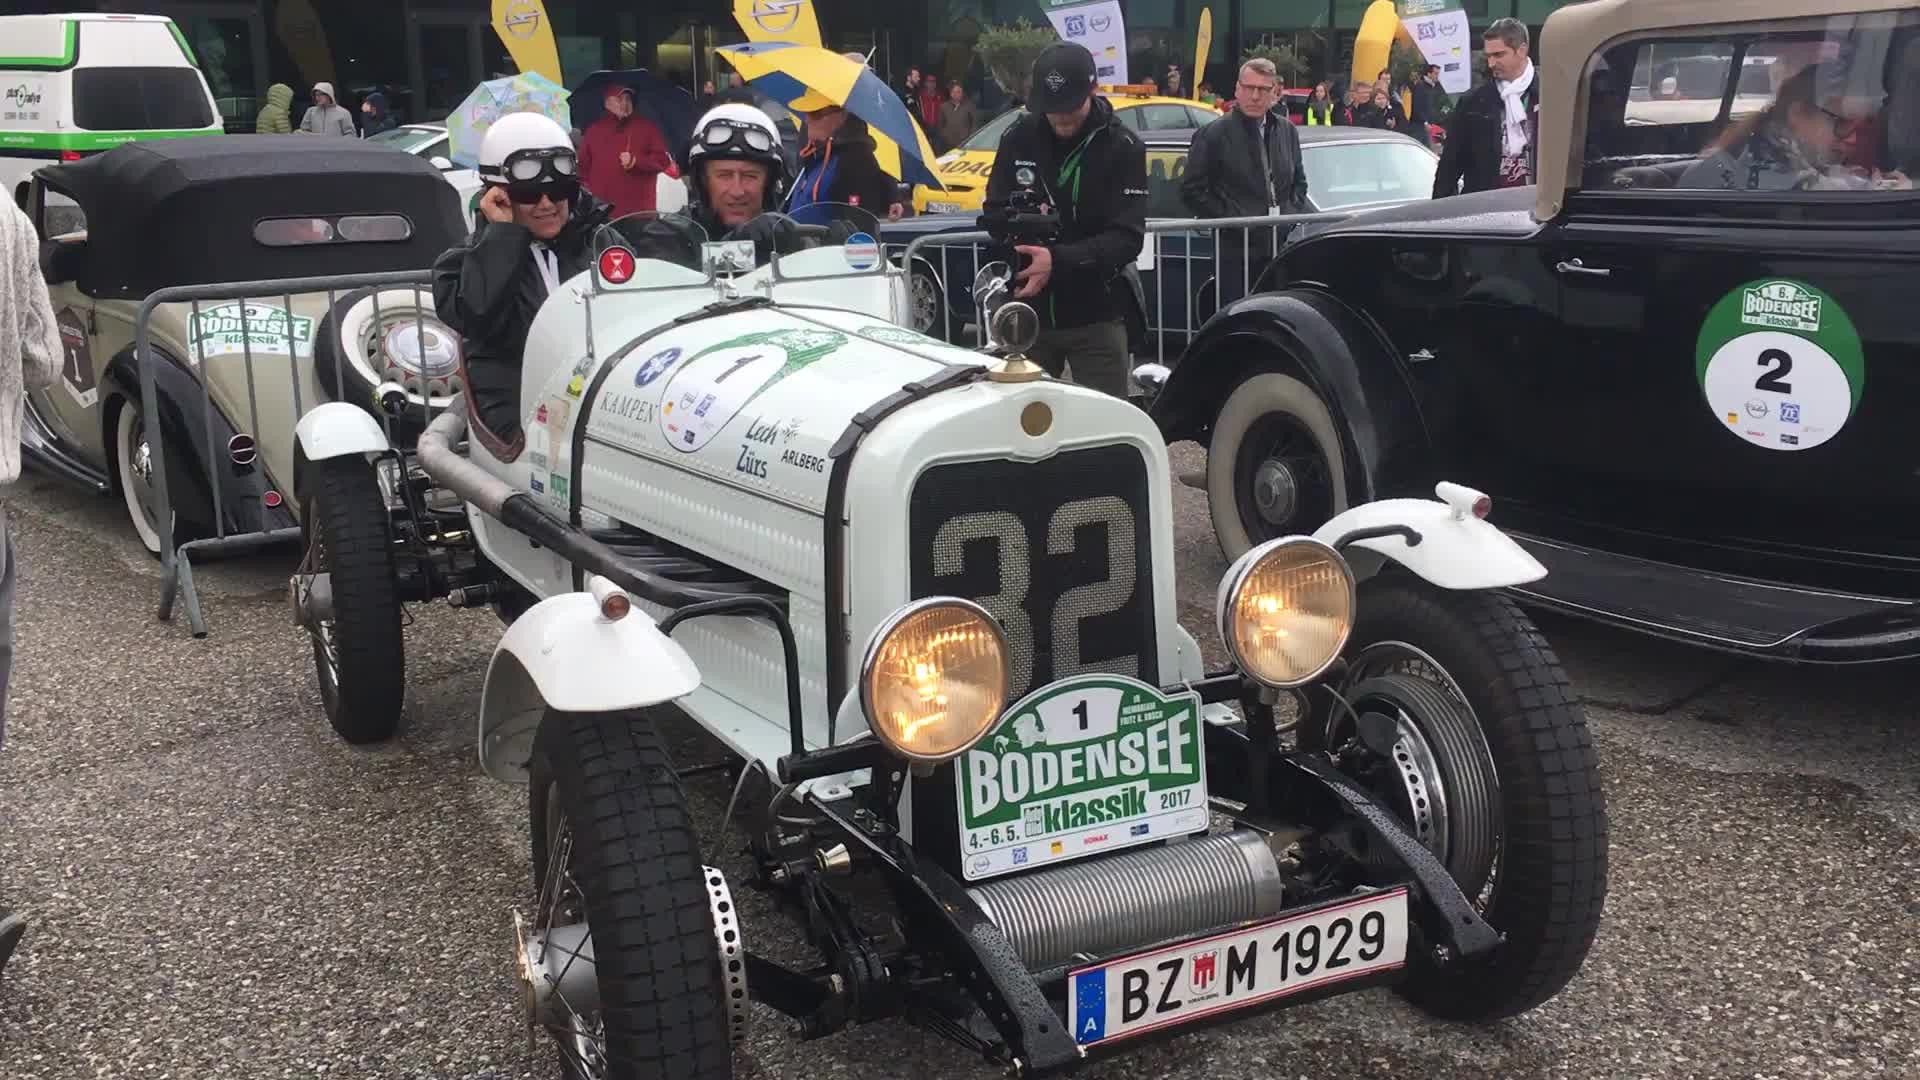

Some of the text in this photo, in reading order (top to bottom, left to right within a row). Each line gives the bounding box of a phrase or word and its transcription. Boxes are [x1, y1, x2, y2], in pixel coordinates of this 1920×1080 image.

[1746, 292, 1818, 321] BODENSEE
[714, 354, 764, 384] 1
[1755, 348, 1792, 394] 2
[600, 391, 655, 424] KAMPEN
[745, 415, 781, 445] Lech
[736, 444, 768, 479] Zürs
[781, 449, 825, 473] ARLBERG
[933, 495, 1139, 700] 32
[1072, 700, 1088, 730] 1
[969, 709, 1193, 818] BODENSEE
[1043, 786, 1147, 834] klassik
[1160, 789, 1191, 810] 2017
[1122, 911, 1385, 1024] BZ M 1929
[1083, 1017, 1097, 1034] A
